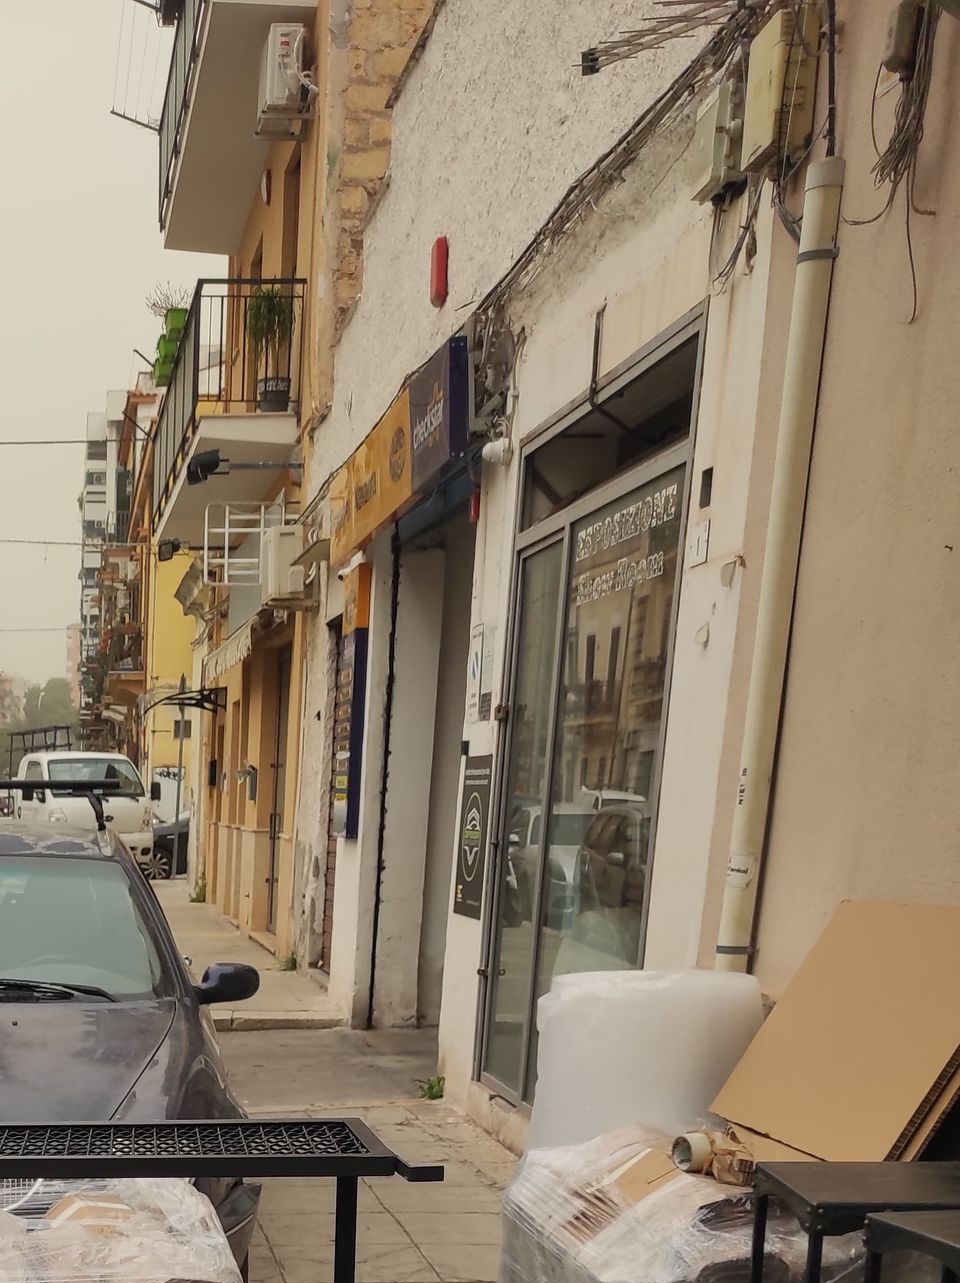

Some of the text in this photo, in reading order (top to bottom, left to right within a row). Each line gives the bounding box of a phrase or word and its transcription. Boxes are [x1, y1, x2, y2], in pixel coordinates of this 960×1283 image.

[413, 398, 444, 450] checkstar
[576, 484, 677, 562] ESPOSIZIONE
[615, 551, 664, 591] Room
